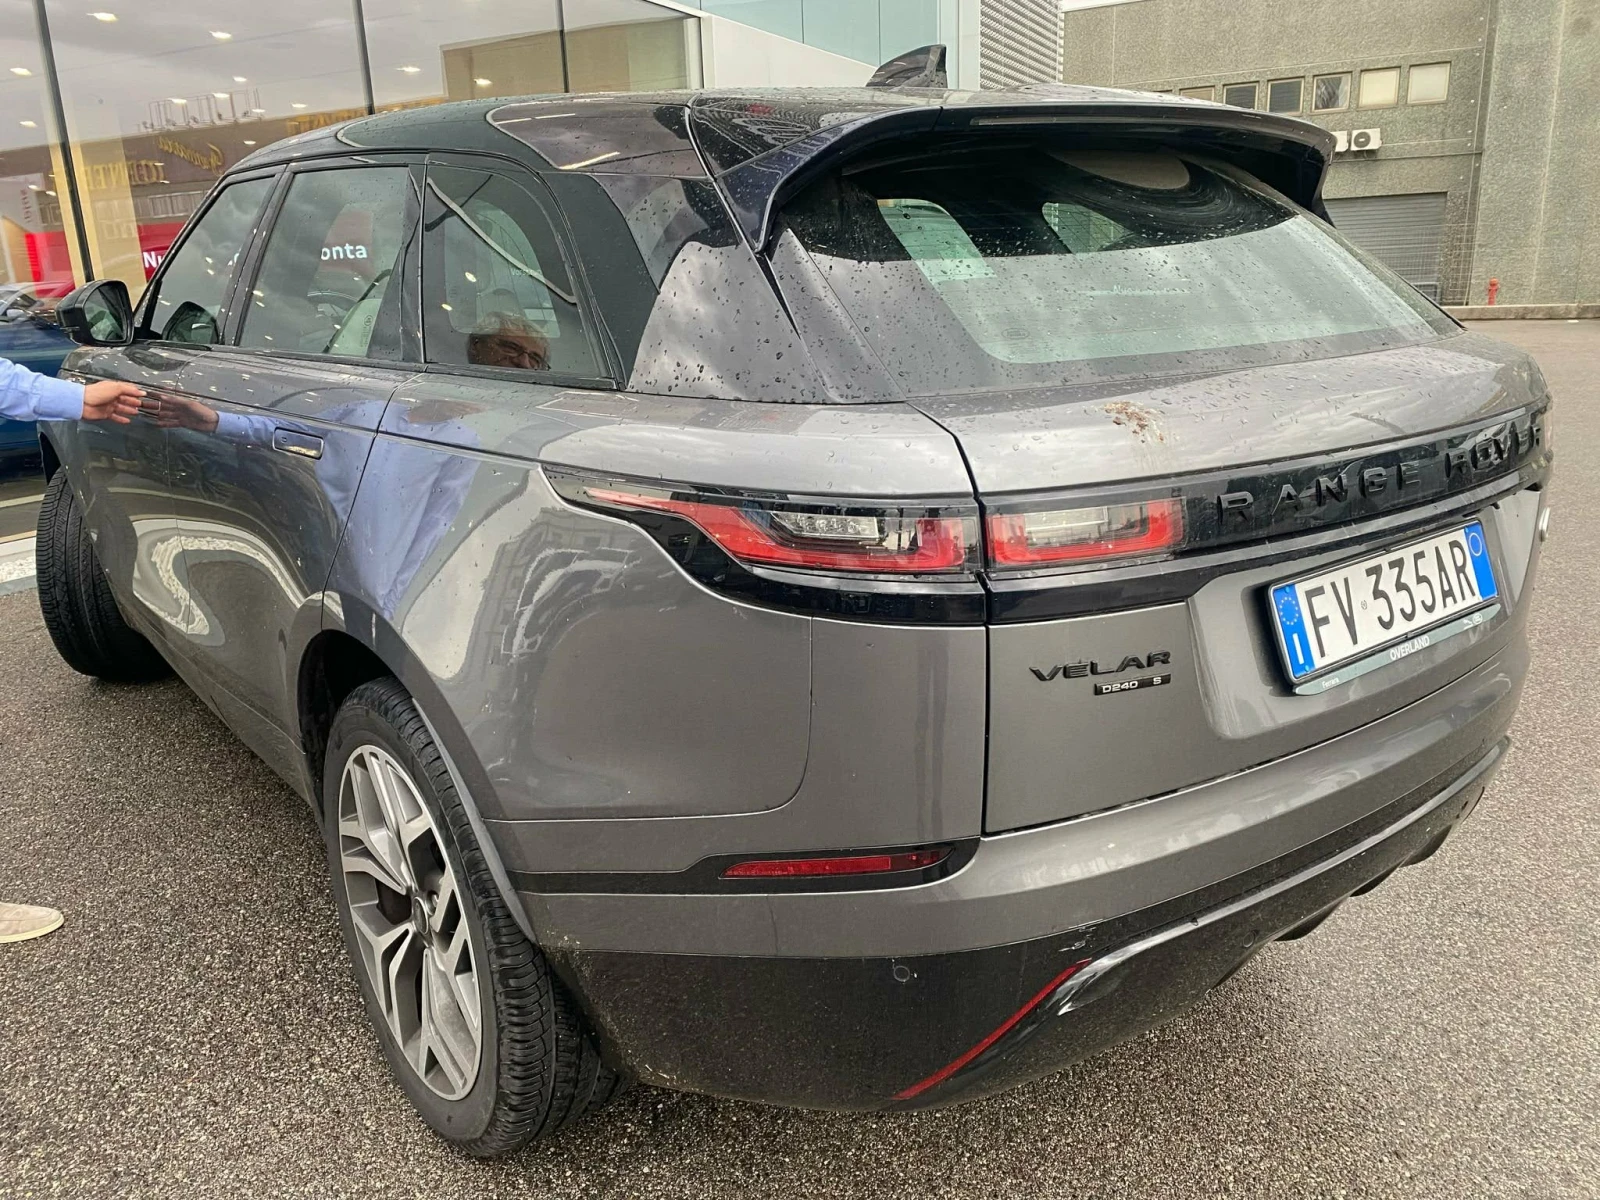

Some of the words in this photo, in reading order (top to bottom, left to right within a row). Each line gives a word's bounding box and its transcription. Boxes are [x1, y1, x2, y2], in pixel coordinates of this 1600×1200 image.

[1217, 459, 1422, 526] RANGE
[1304, 576, 1359, 658] FV
[1365, 539, 1477, 630] 335AR
[1389, 635, 1430, 661] OVERLAND
[1029, 651, 1171, 682] VELAR
[1102, 680, 1139, 694] D240
[1153, 676, 1162, 686] S
